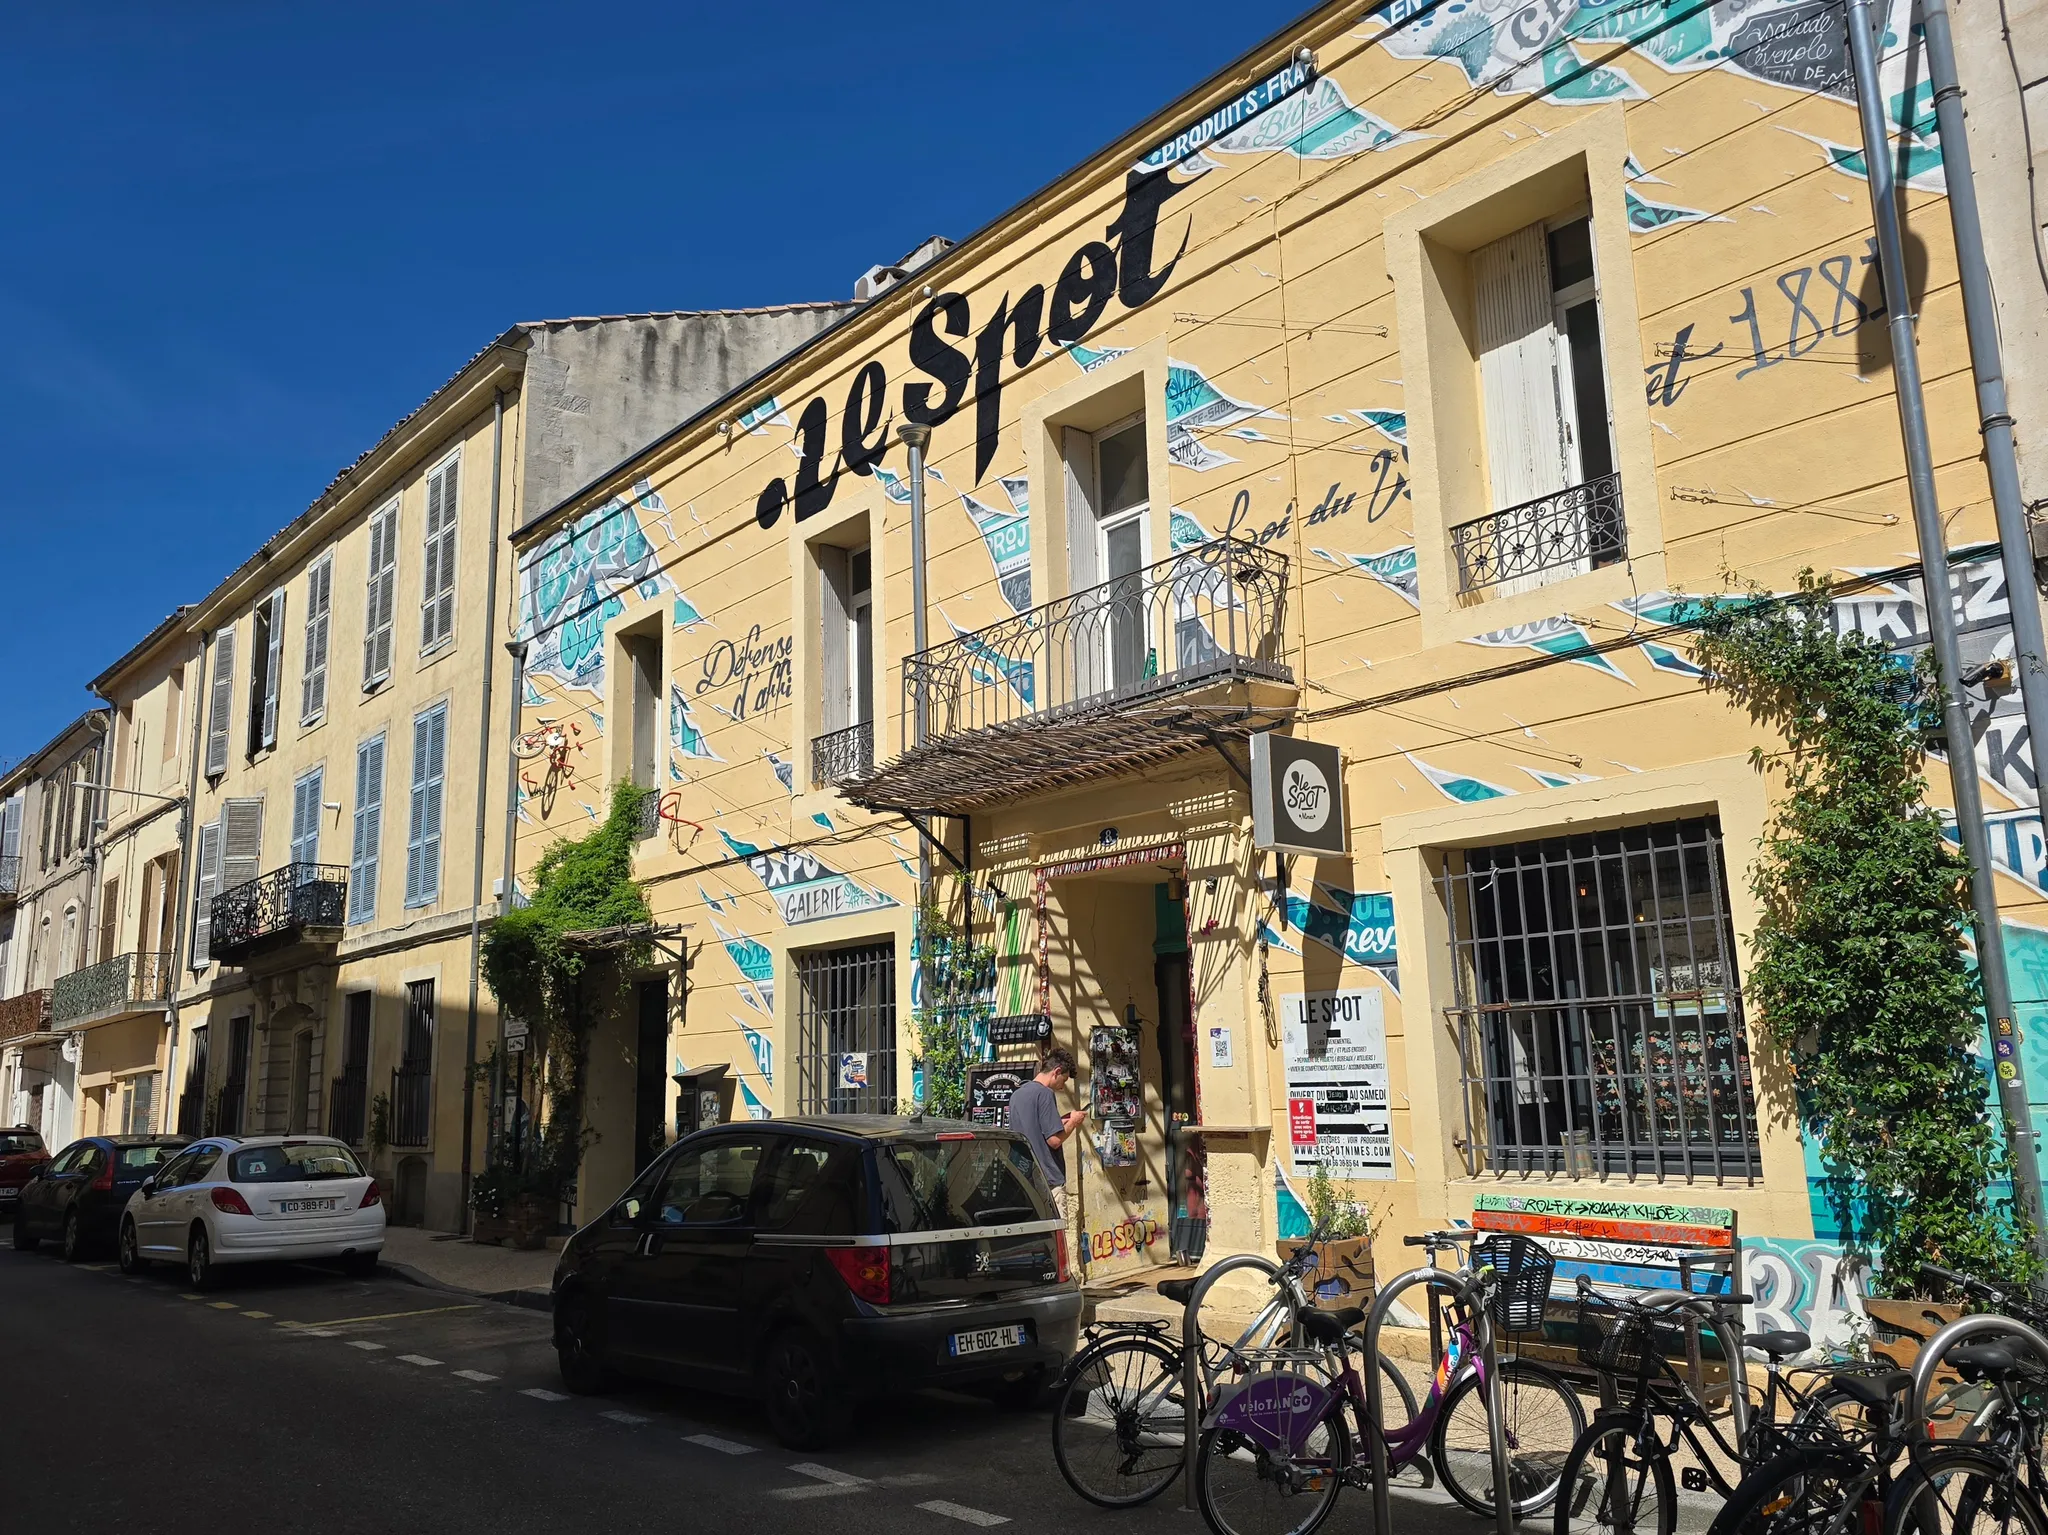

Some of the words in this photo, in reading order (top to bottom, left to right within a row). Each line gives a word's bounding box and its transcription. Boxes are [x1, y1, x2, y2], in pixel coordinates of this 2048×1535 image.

[1303, 482, 1358, 527] du
[1105, 829, 1113, 844] 8
[785, 884, 844, 923] GALERIE
[1299, 999, 1318, 1024] LE
[1321, 996, 1361, 1022] SPOT
[1317, 1090, 1325, 1100] DU
[1350, 1090, 1358, 1100] AU
[1360, 1089, 1386, 1100] SAMEDI
[1361, 1136, 1389, 1144] PROGRAMME
[934, 1226, 1025, 1240] PEUGEOT
[1093, 1230, 1114, 1260] LE
[1114, 1220, 1156, 1252] SPOT
